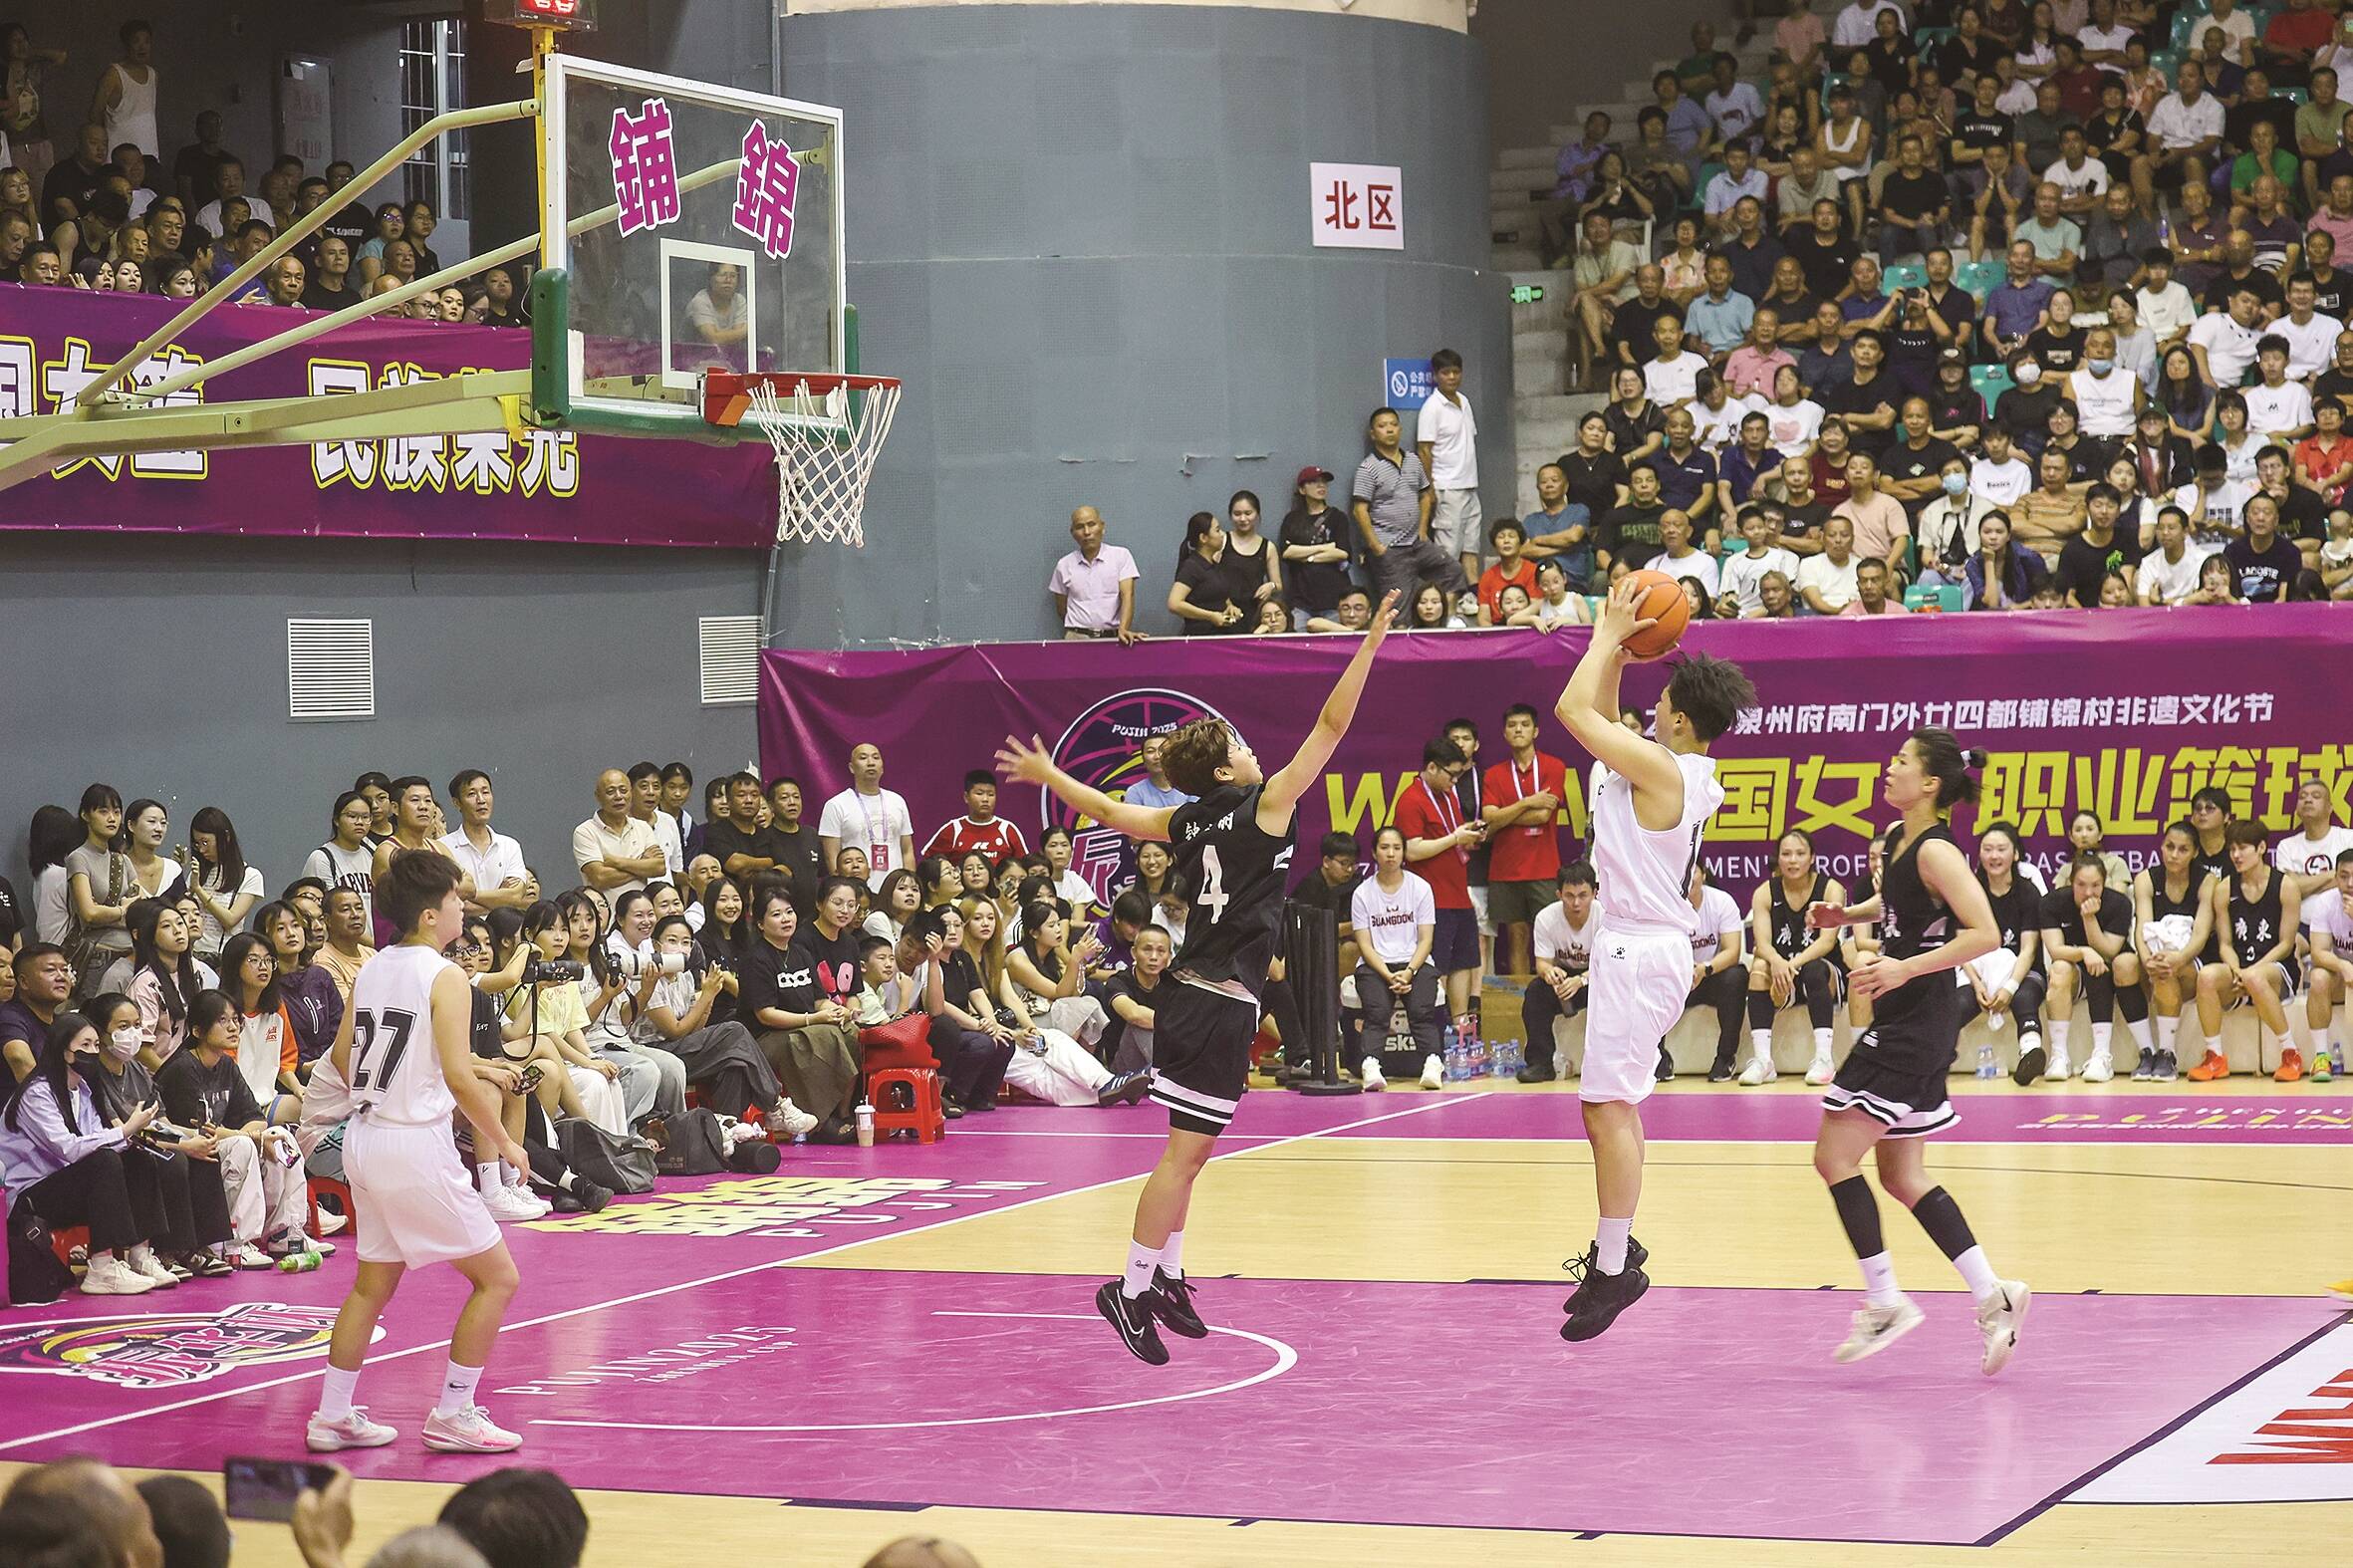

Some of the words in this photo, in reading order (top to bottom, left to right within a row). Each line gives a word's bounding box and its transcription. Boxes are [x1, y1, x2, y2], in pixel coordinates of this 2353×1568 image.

[1325, 180, 1397, 230] 北区
[1197, 845, 1230, 924] 4
[351, 1006, 417, 1093] 27
[746, 1179, 1051, 1238] PUJIN
